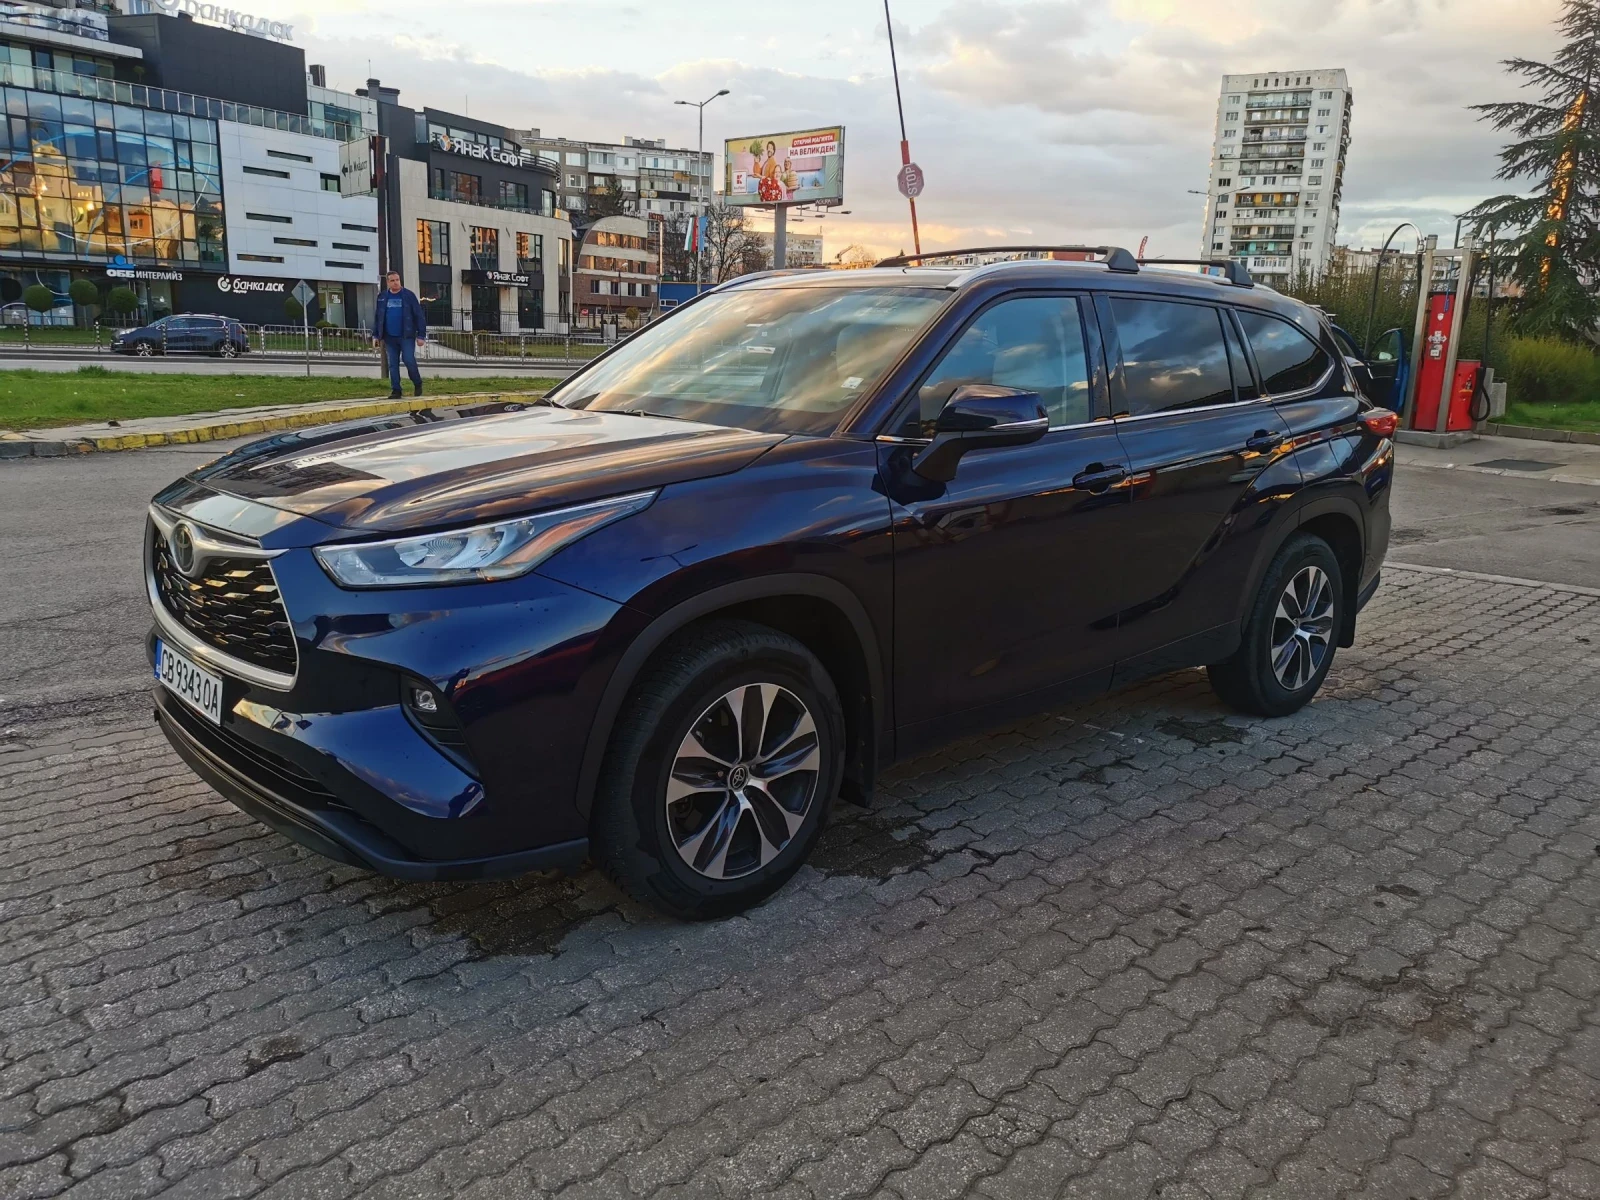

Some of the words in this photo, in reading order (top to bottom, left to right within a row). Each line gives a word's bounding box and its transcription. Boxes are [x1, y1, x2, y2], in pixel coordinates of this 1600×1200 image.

[453, 138, 489, 160] Янак
[490, 146, 526, 167] Софт
[799, 144, 836, 156] ВЕЛИКДЕН!
[905, 166, 918, 195] STOP
[106, 268, 135, 278] ОББ
[135, 270, 183, 281] ИНТЕРЛИЙЗ
[493, 271, 511, 281] Янак
[511, 273, 529, 283] Софт
[233, 278, 265, 291] банка
